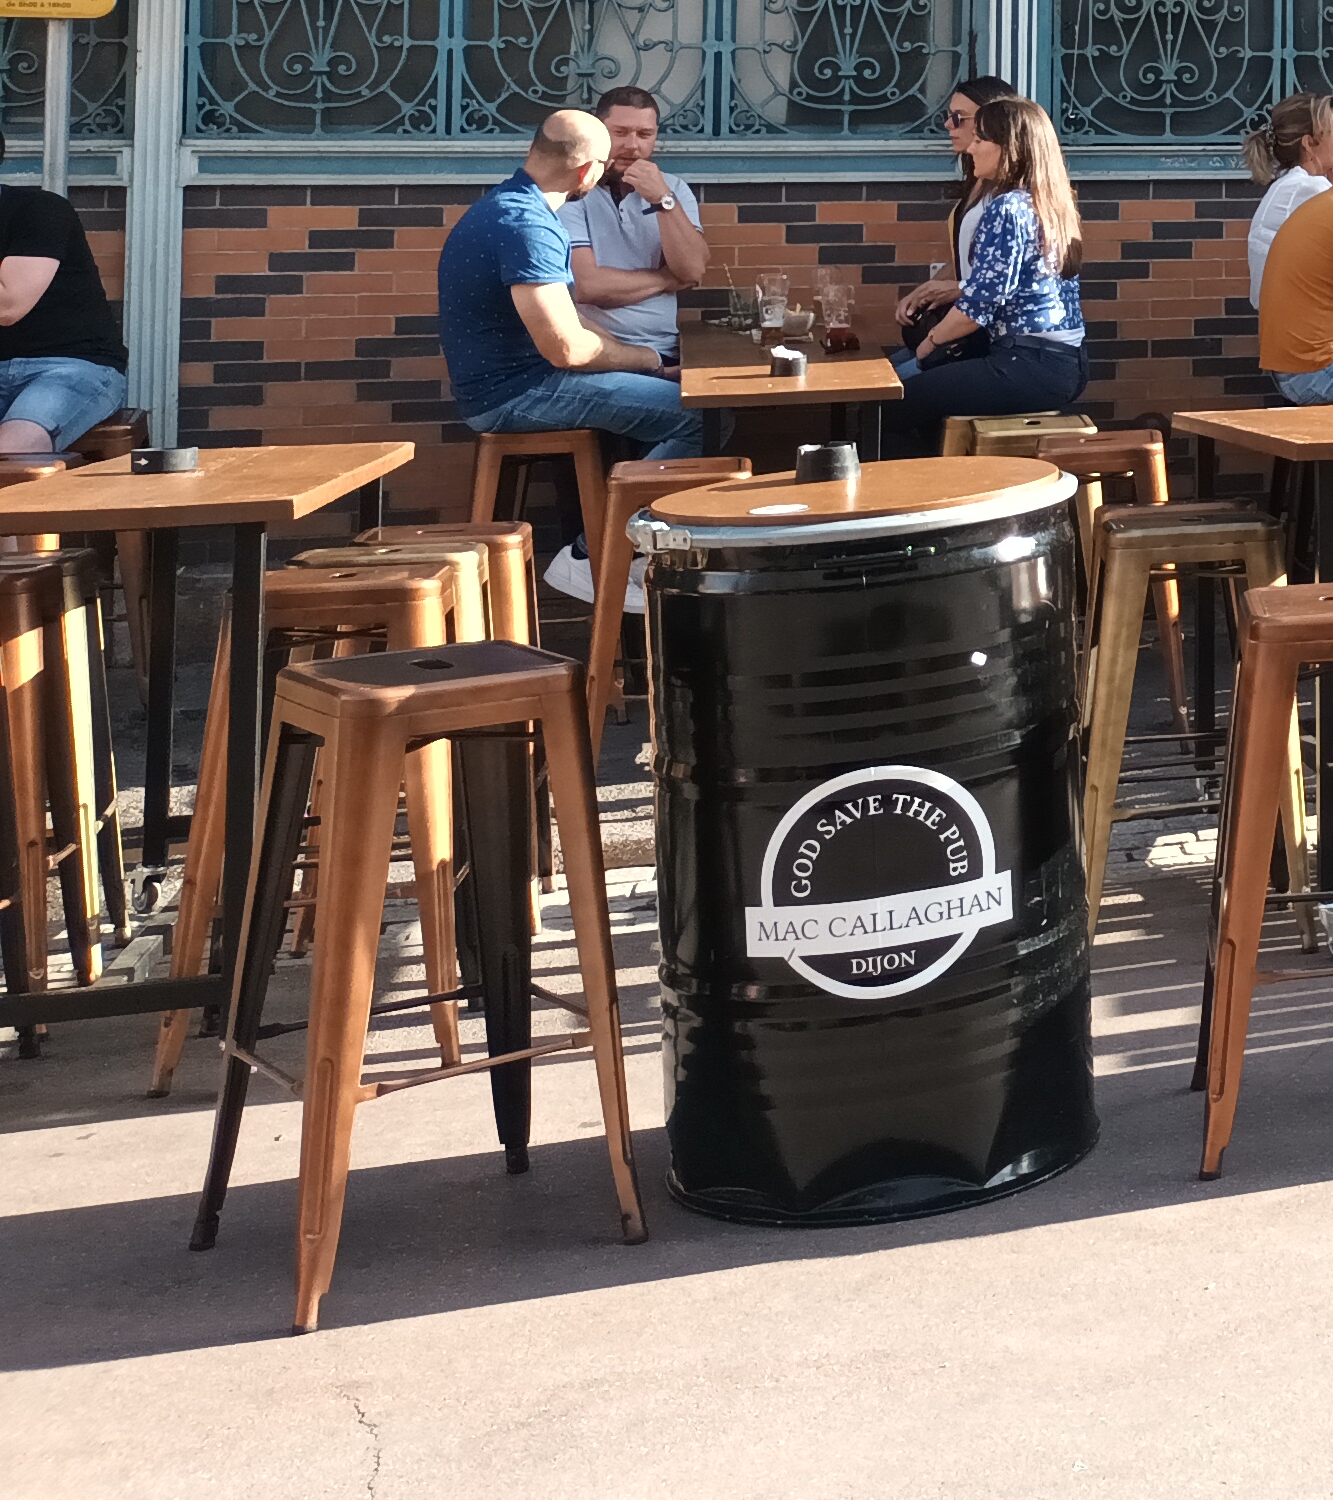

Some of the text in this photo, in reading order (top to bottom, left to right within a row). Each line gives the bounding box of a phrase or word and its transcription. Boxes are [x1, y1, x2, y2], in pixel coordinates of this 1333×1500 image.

[790, 794, 968, 898] GOD SAVE THE PUB
[757, 887, 1003, 942] MAC CALLAGHAN
[851, 950, 916, 975] DIJON
